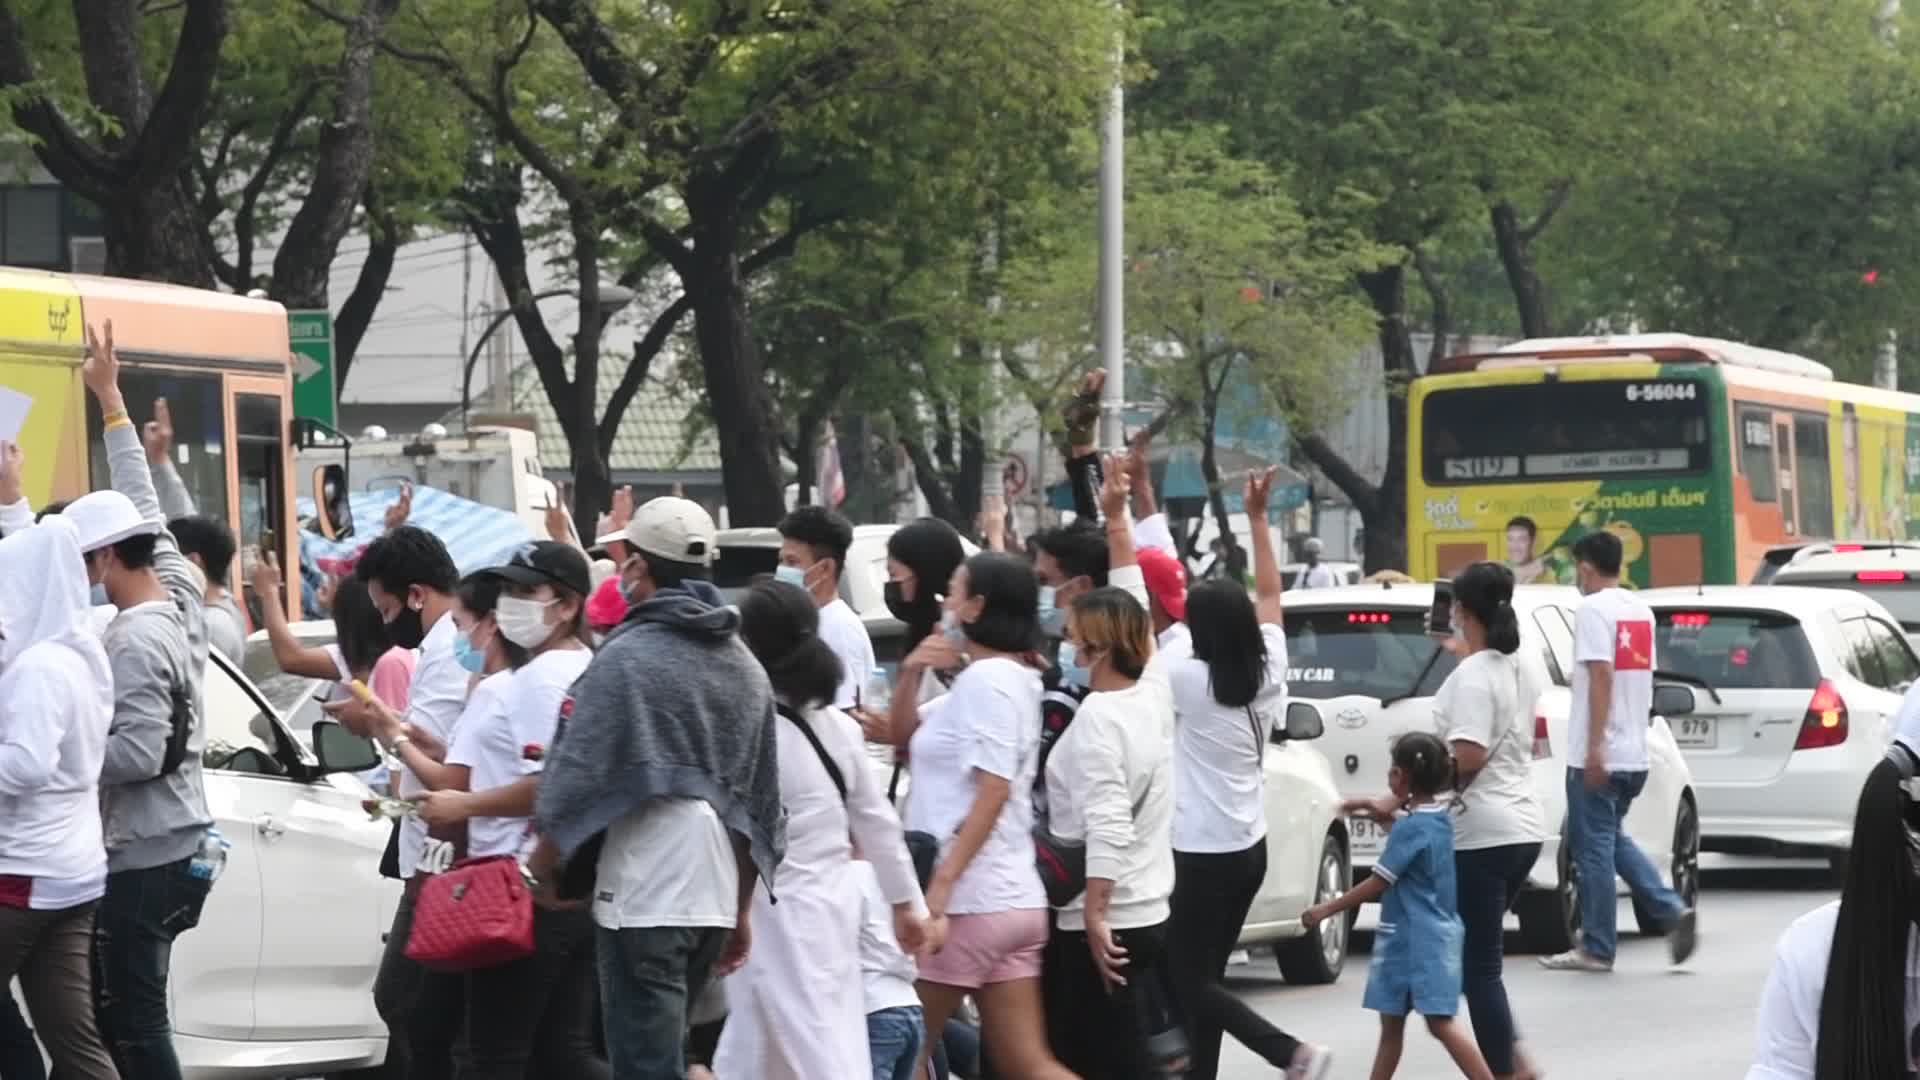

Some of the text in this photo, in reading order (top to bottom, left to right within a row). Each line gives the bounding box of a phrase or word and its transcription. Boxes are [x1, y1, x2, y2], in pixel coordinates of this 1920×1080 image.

[1626, 383, 1697, 402] 6-56044
[1304, 667, 1335, 682] CAR
[1682, 719, 1709, 735] 979
